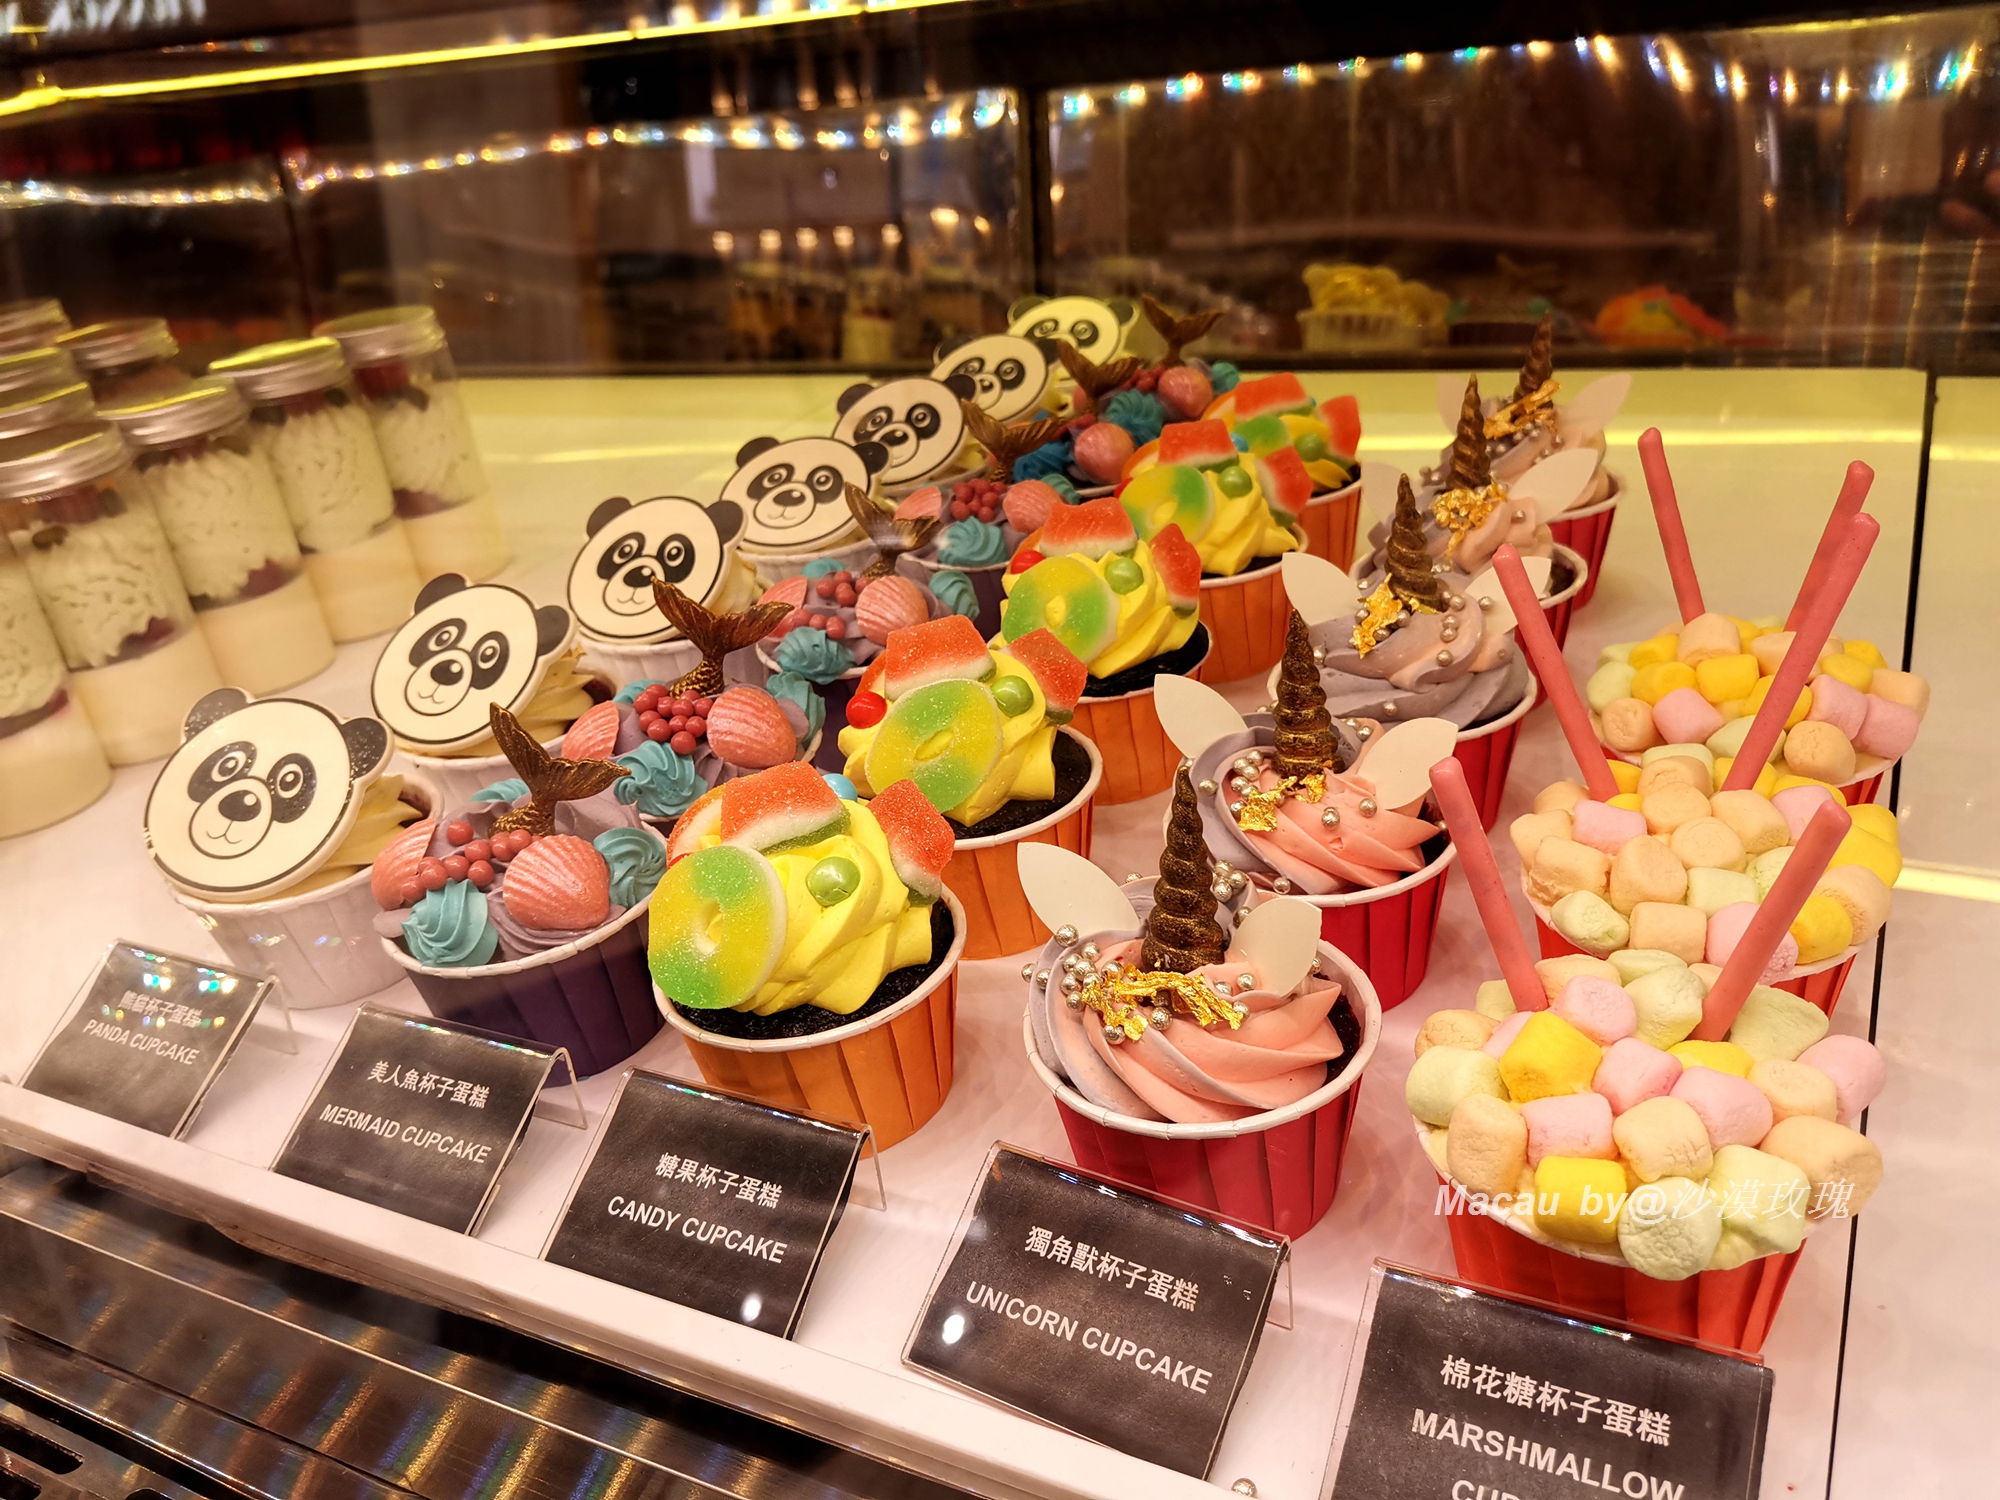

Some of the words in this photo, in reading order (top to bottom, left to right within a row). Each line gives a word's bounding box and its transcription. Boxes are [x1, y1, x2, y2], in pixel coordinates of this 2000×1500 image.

[82, 1019, 129, 1044] PANDA
[130, 1033, 200, 1065] CUPCAKE
[367, 1060, 490, 1109] 美人魚杯子蛋糕
[319, 1104, 401, 1139] MERMAID
[401, 1125, 492, 1163] CUPCAKE
[655, 1152, 783, 1209] 糖果杯子蛋糕
[607, 1196, 681, 1231] CANDY
[682, 1217, 788, 1264] CUPCAKE
[1024, 1225, 1199, 1312] 獨角獸杯子蛋糕
[966, 1281, 1079, 1342] UNICORN
[1082, 1327, 1213, 1394] CUPCAKE
[1440, 1354, 1672, 1447] 棉花糖杯子蛋糕
[1411, 1408, 1685, 1500] MARSHMALLOW
